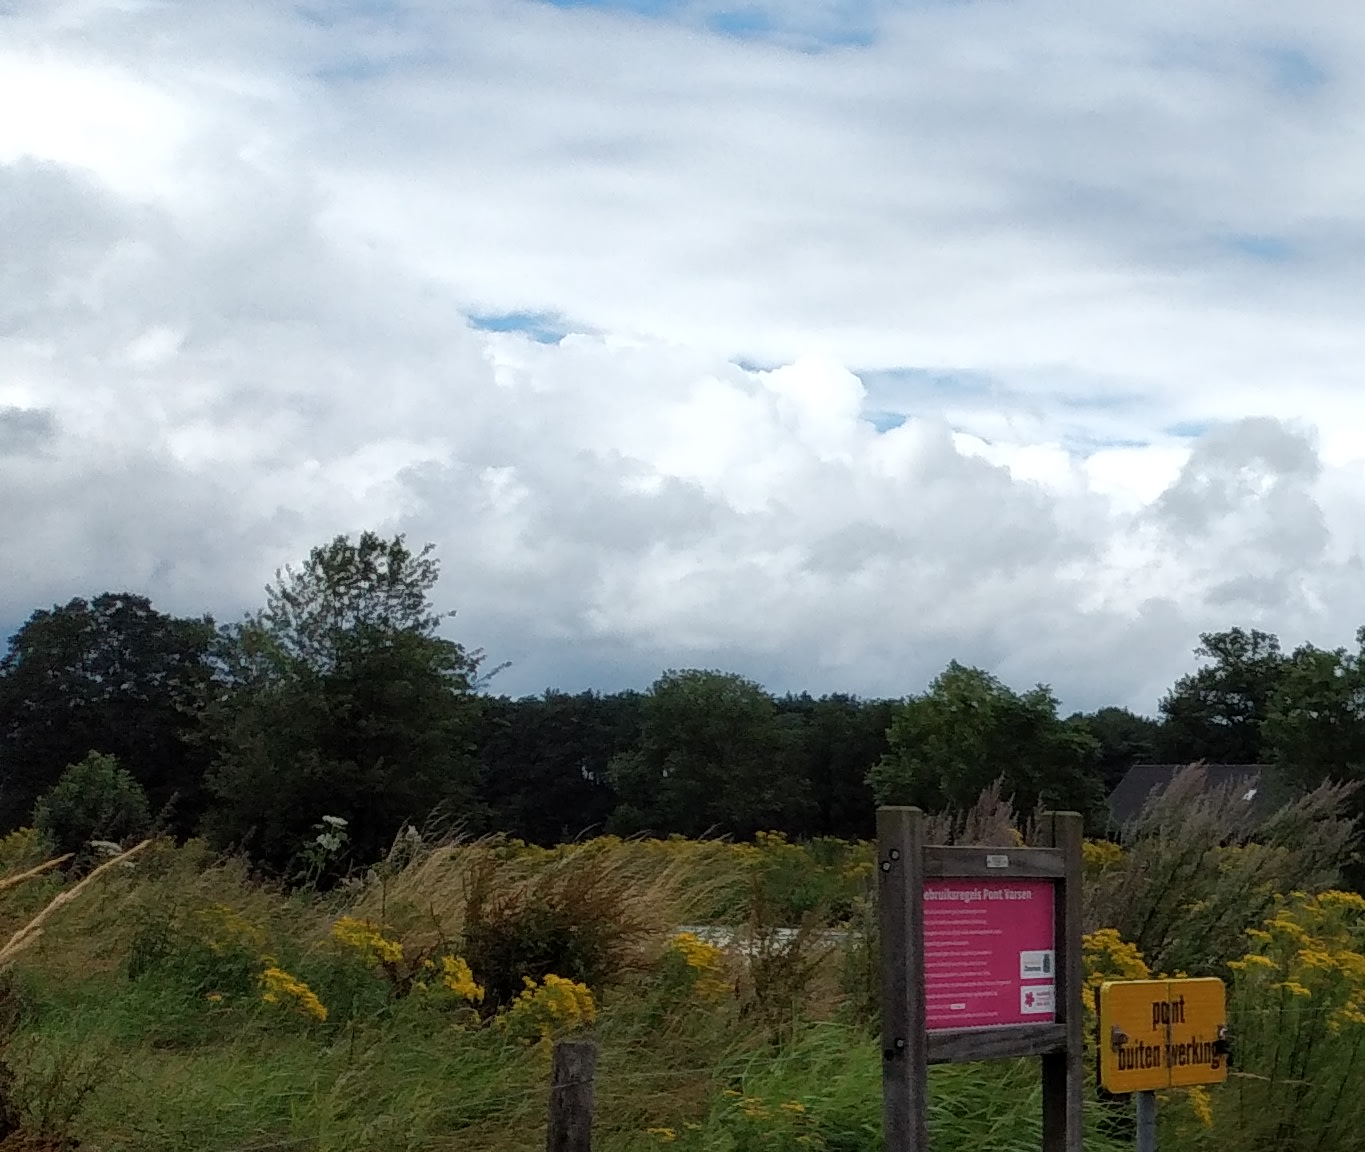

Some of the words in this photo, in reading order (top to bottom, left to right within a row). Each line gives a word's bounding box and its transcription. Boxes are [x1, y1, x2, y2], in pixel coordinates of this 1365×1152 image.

[923, 887, 982, 903] ebruiksregels
[983, 888, 1004, 900] Pont
[1152, 995, 1186, 1032] pont
[1118, 1039, 1161, 1071] buiten
[1165, 1036, 1220, 1070] werking
